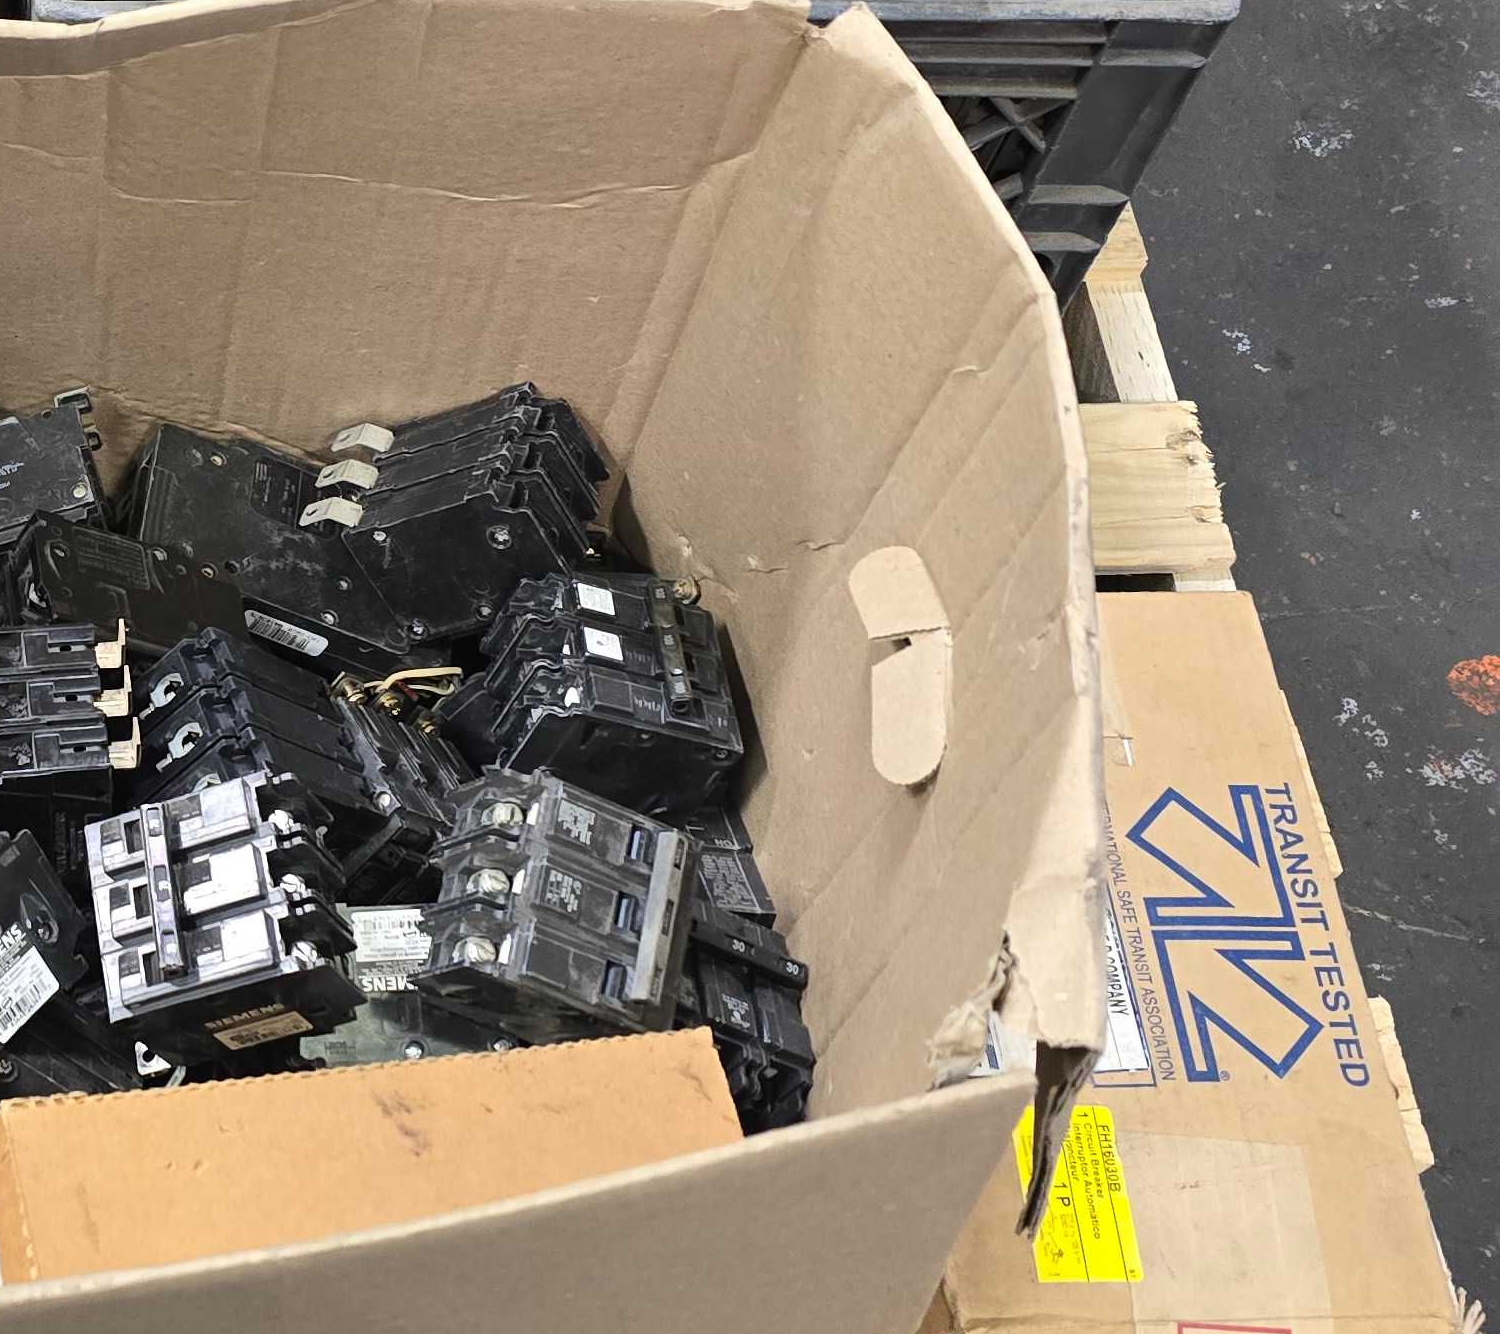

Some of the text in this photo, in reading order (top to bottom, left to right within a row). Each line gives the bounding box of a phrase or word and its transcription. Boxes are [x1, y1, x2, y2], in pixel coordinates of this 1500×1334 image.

[1117, 889, 1138, 924] SAFE
[731, 939, 800, 975] 30 30
[1126, 925, 1153, 984] TRANSIT
[1264, 781, 1371, 1087] TRANSIT TESTED
[203, 1003, 285, 1029] SIEMENS
[1142, 986, 1177, 1082] ASSOCIATION
[1084, 1122, 1105, 1199] Circuit Breaker
[1055, 1196, 1071, 1208] P
